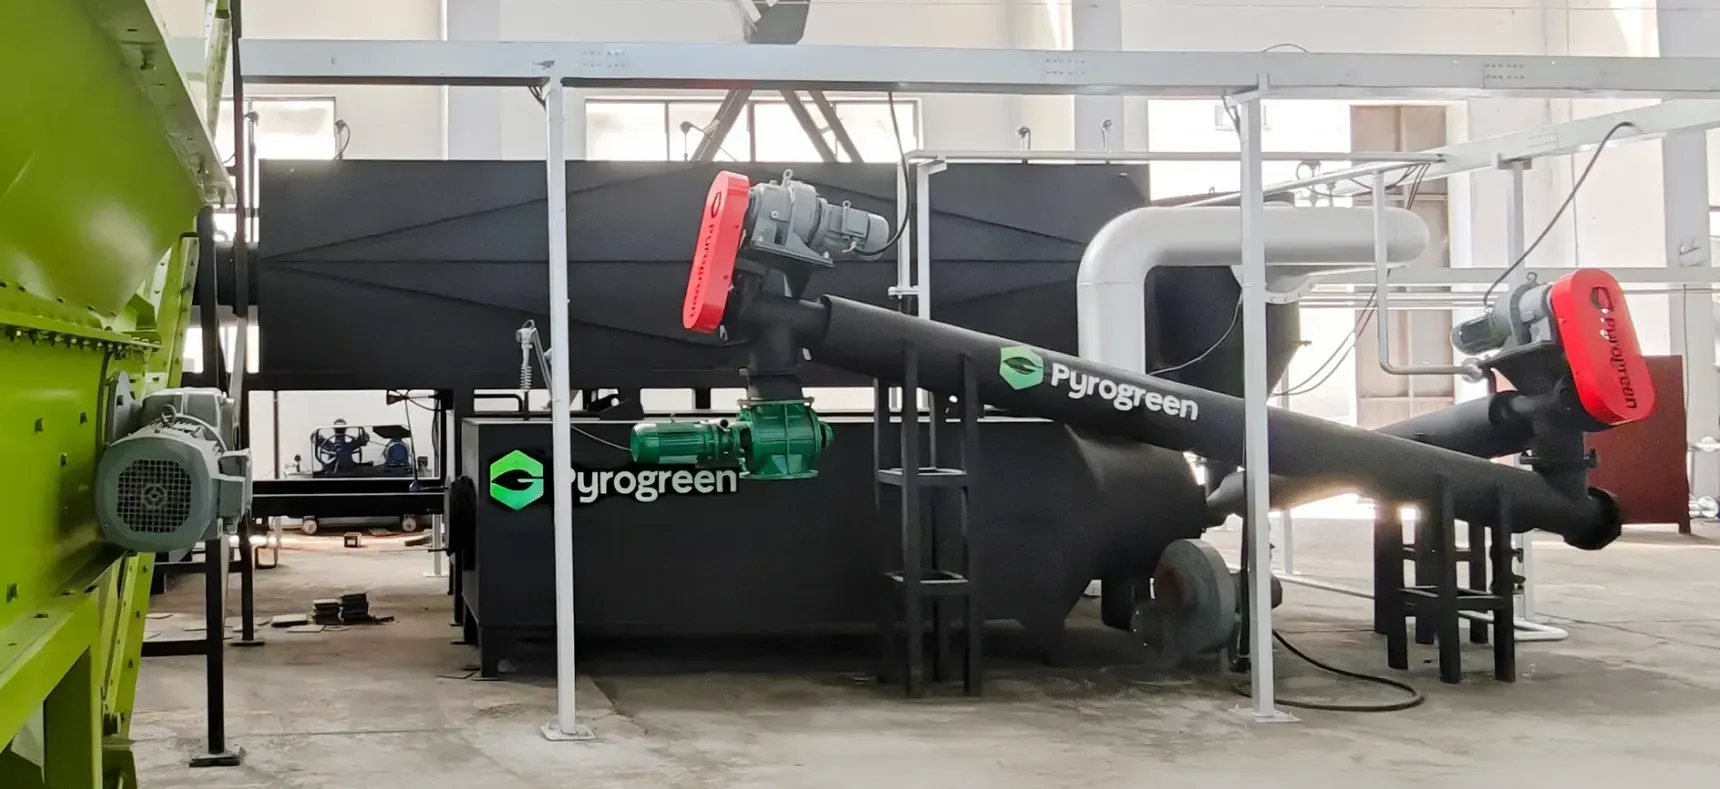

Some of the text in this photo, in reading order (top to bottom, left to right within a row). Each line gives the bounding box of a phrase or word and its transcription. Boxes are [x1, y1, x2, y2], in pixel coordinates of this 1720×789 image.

[1051, 363, 1199, 421] Pyrogreen
[1600, 317, 1638, 409] Pyrogreen
[571, 468, 737, 503] yrogreen
